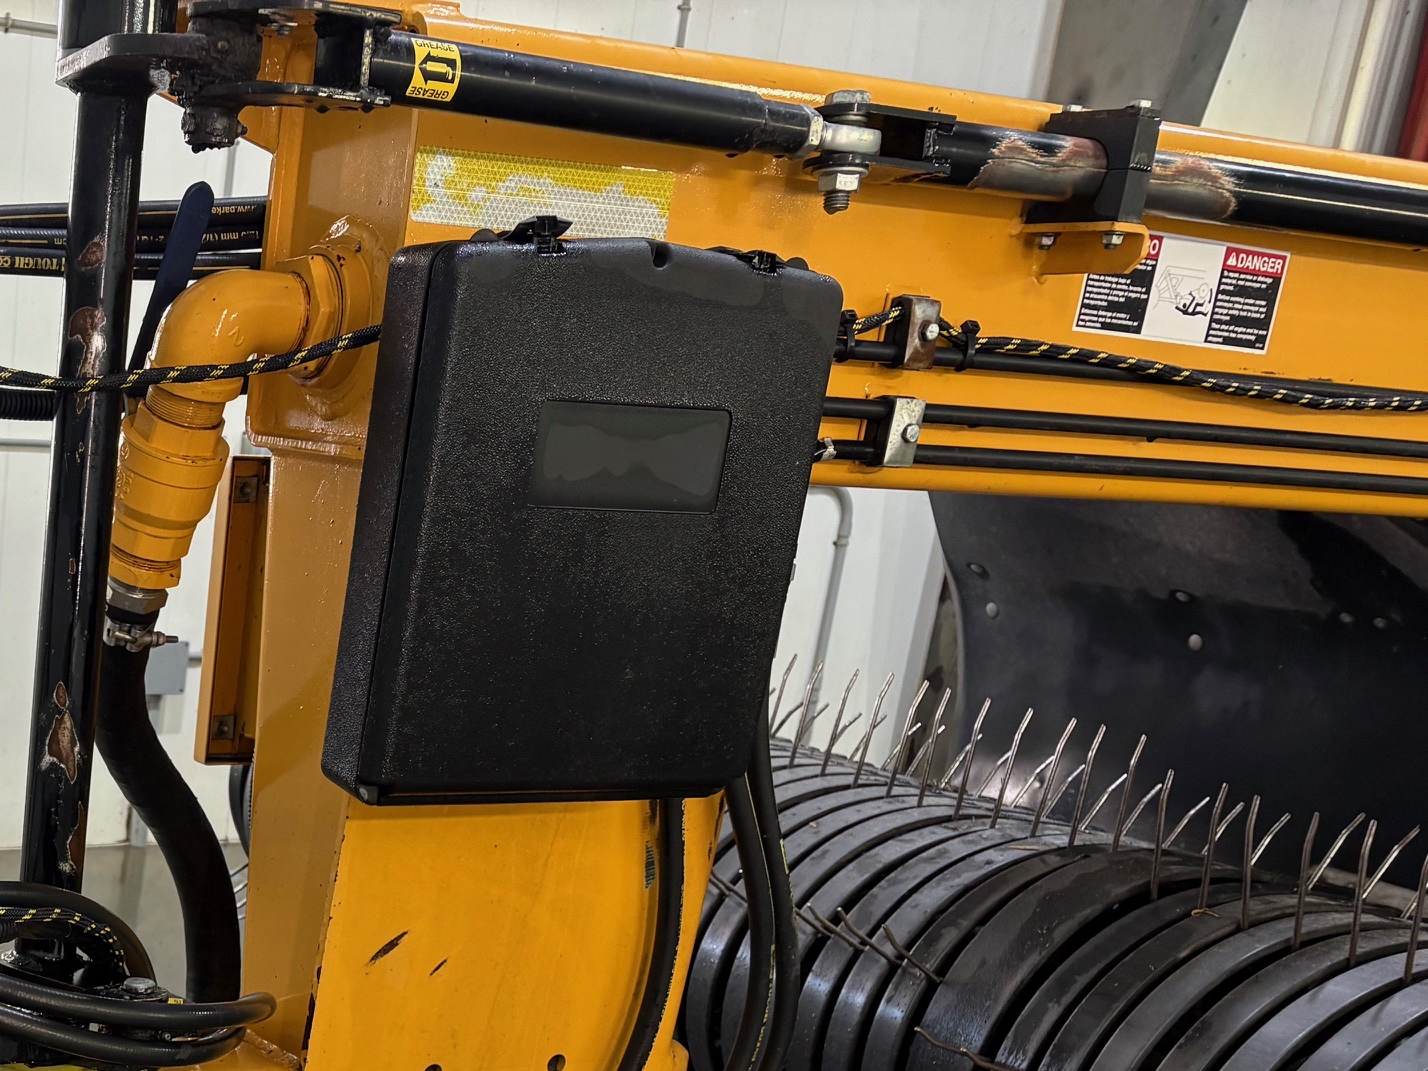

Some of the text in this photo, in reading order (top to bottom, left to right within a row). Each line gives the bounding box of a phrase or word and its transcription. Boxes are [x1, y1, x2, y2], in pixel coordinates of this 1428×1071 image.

[415, 40, 454, 52] GREASE
[408, 86, 449, 99] GREASE
[14, 256, 59, 271] TOUGH
[1238, 254, 1283, 273] DANGER
